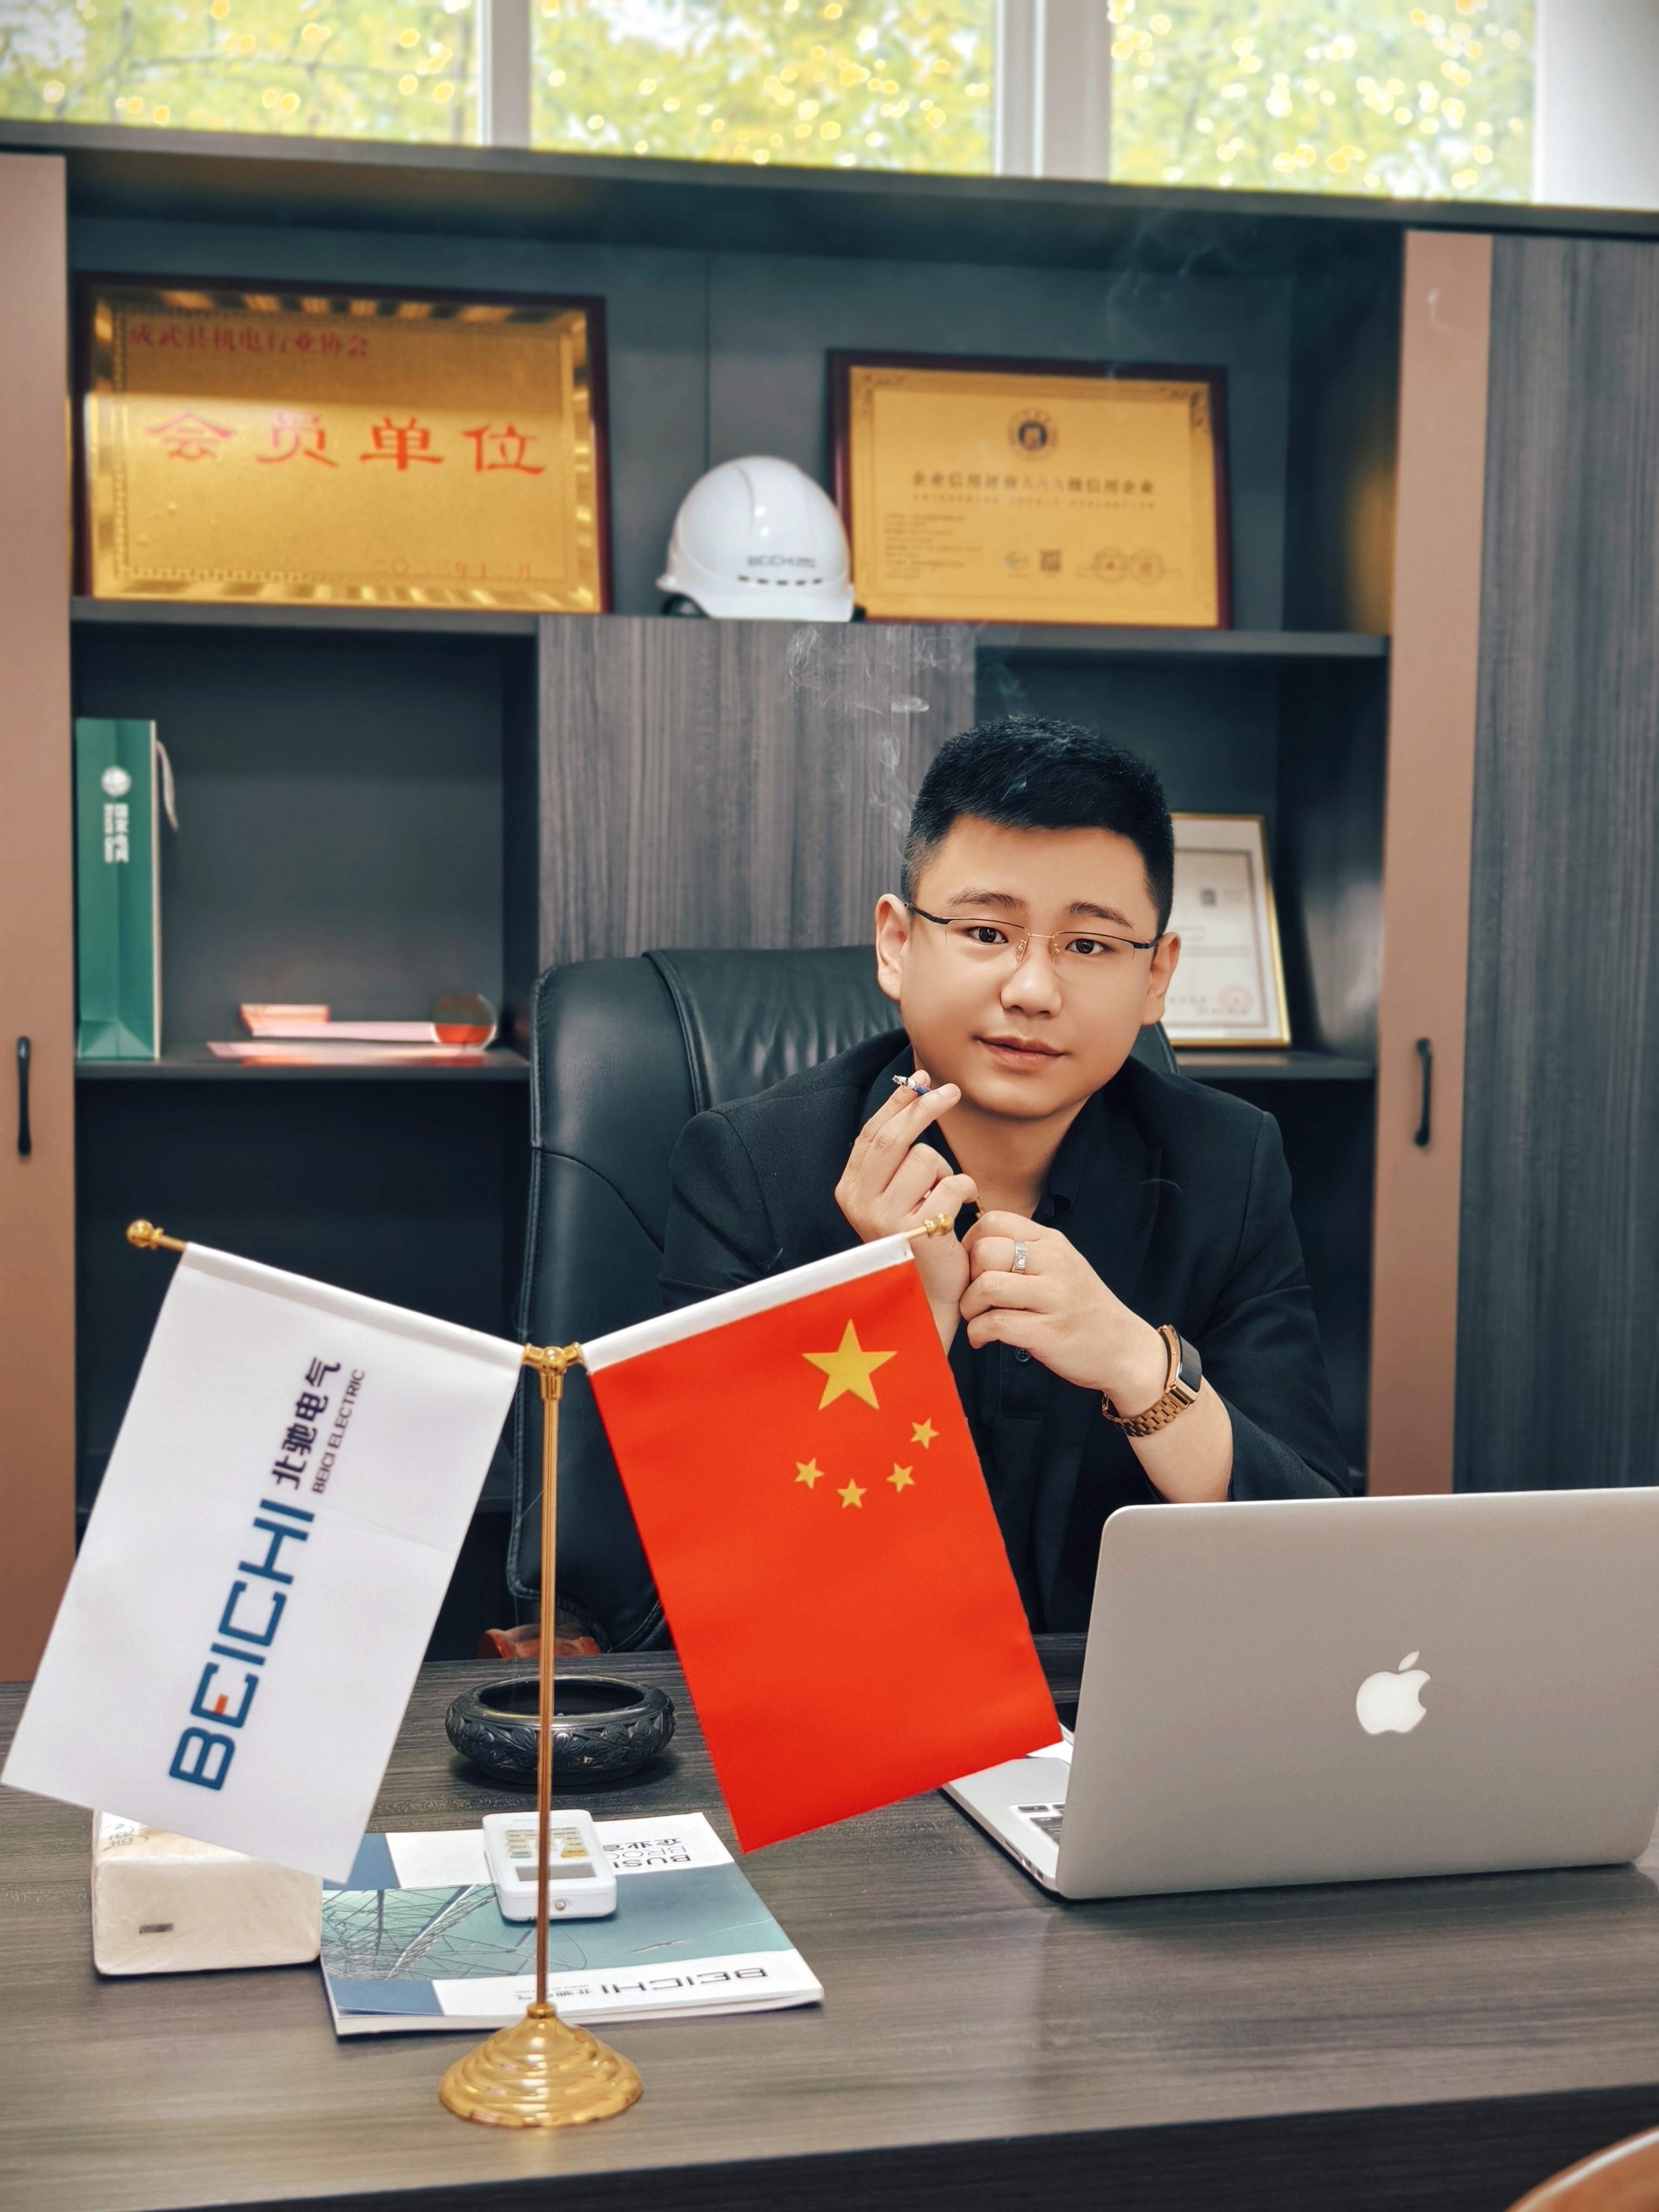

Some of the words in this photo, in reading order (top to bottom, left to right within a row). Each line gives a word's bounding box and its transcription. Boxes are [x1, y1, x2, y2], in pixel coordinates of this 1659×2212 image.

[147, 412, 545, 474] 会员单位
[272, 1357, 341, 1491] 北驰电气
[312, 1451, 336, 1494] BEICI
[327, 1368, 365, 1449] ELECTRIC
[168, 1498, 315, 1791] BEICHI
[601, 1967, 768, 1994] BEICHI
